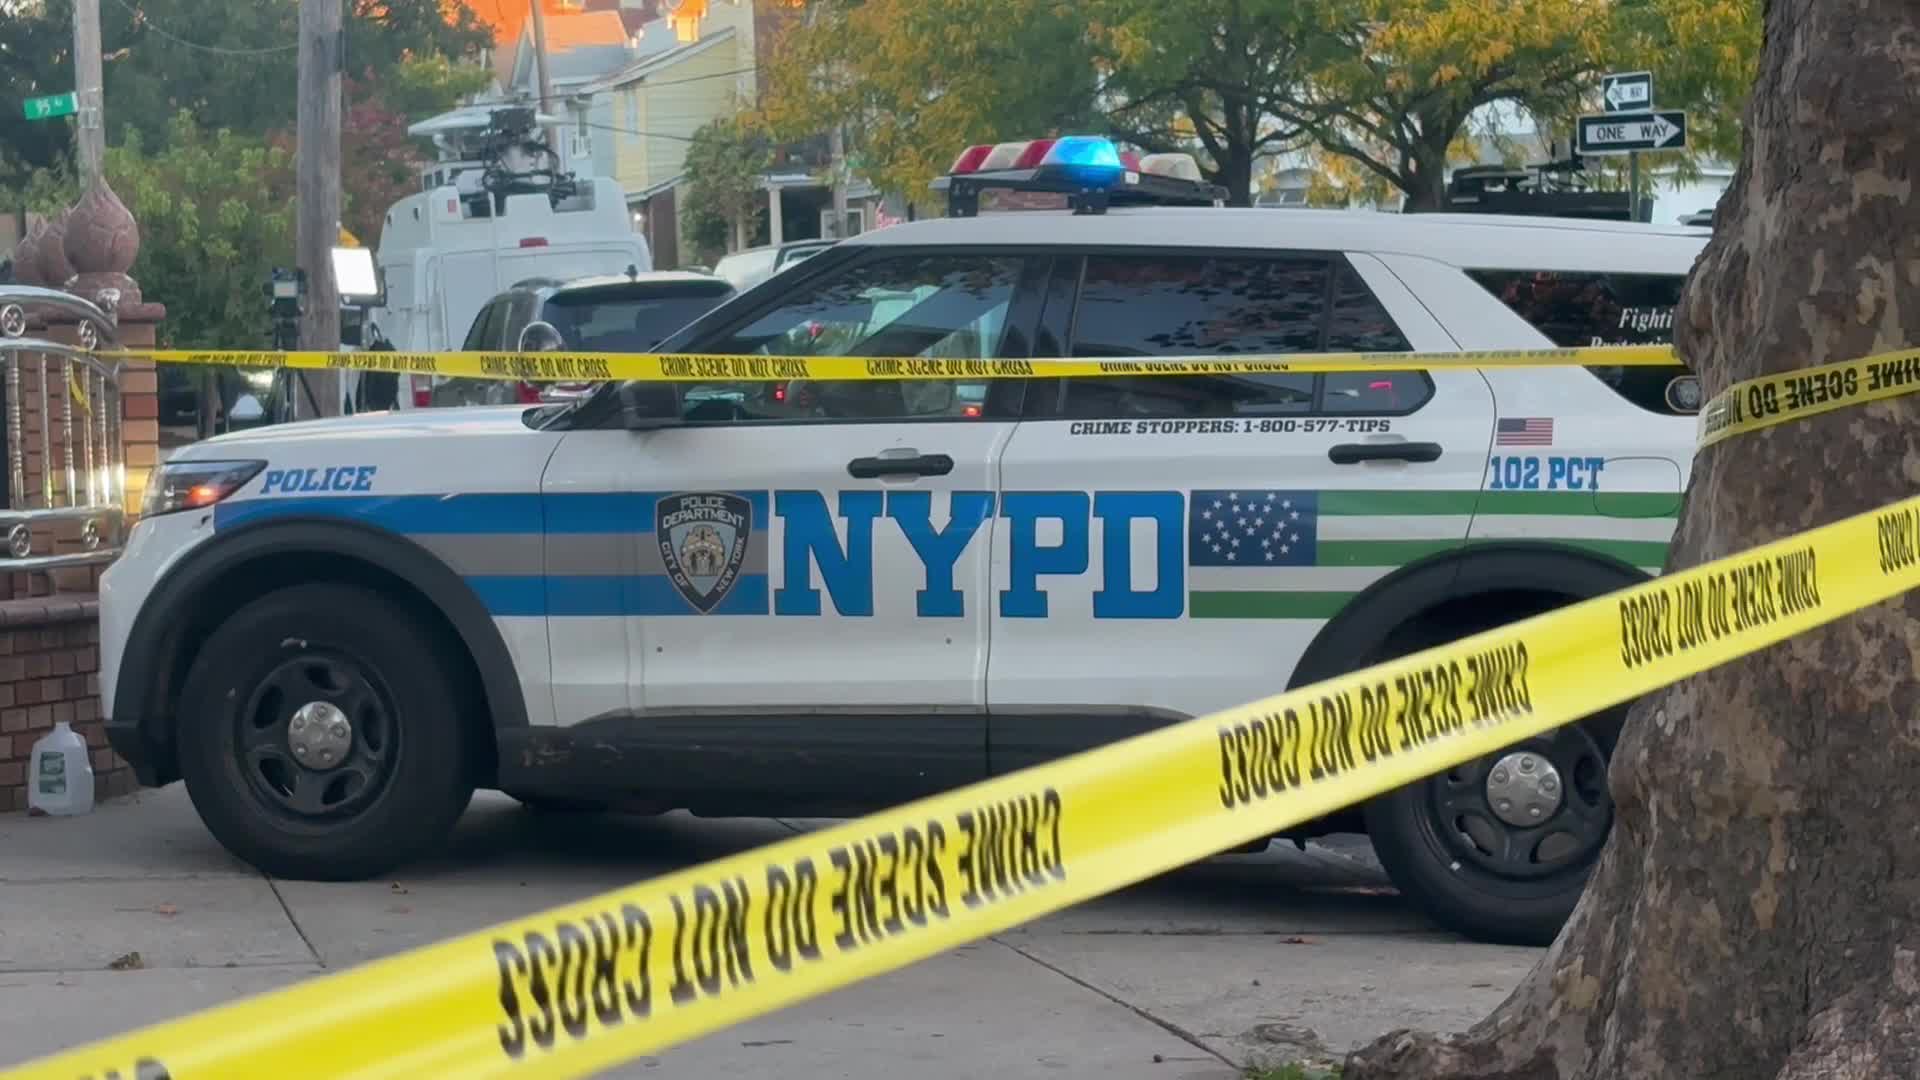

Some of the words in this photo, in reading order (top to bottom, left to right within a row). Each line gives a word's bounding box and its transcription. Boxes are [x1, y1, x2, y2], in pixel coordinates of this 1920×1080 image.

[1596, 126, 1626, 140] ONE
[1640, 124, 1668, 138] WAY
[1618, 307, 1674, 332] Fighti
[480, 355, 509, 374] CRIME
[510, 356, 541, 376] SCENE
[540, 357, 556, 376] DO
[555, 357, 576, 377] NOT
[577, 358, 612, 378] CROSS
[660, 356, 695, 376] CRIME
[695, 357, 731, 377] SCENE
[730, 357, 747, 377] DO
[748, 358, 770, 377] NOT
[771, 358, 809, 377] CROSS
[866, 359, 905, 375] CRIME
[965, 359, 989, 375] NOT
[1748, 383, 1780, 419] DO
[1784, 367, 1858, 410] SCENE
[1070, 421, 1132, 436] CRIME
[1136, 420, 1240, 435] STOPPERS:
[1243, 419, 1391, 434] 1-800-577-TIPS
[260, 465, 377, 494] POLICE
[680, 496, 727, 509] POLICE
[1490, 456, 1540, 489] 102
[1547, 456, 1604, 490] PCT
[663, 507, 745, 529] DEPARTMENT
[1878, 508, 1916, 577] CROSS
[661, 541, 678, 569] CITY
[674, 571, 689, 587] OF
[716, 568, 734, 593] NEW
[731, 536, 745, 565] YORK
[774, 489, 1185, 619] NYPD
[1776, 546, 1822, 617] CRIME
[1619, 588, 1673, 669] CROSS
[1675, 578, 1708, 651] NOT
[1708, 571, 1731, 641] DO
[1729, 559, 1777, 632] SCENE
[1395, 660, 1466, 751] SCENE
[1467, 640, 1533, 730] CRIME
[1308, 690, 1357, 782] NOT
[1359, 681, 1393, 763] DO
[1217, 708, 1301, 809] CROSS
[957, 788, 1067, 910] CRIME
[764, 856, 822, 972] DO
[829, 820, 950, 953] SCENE
[669, 876, 755, 1008] NOT
[492, 903, 653, 1060] CROSS
